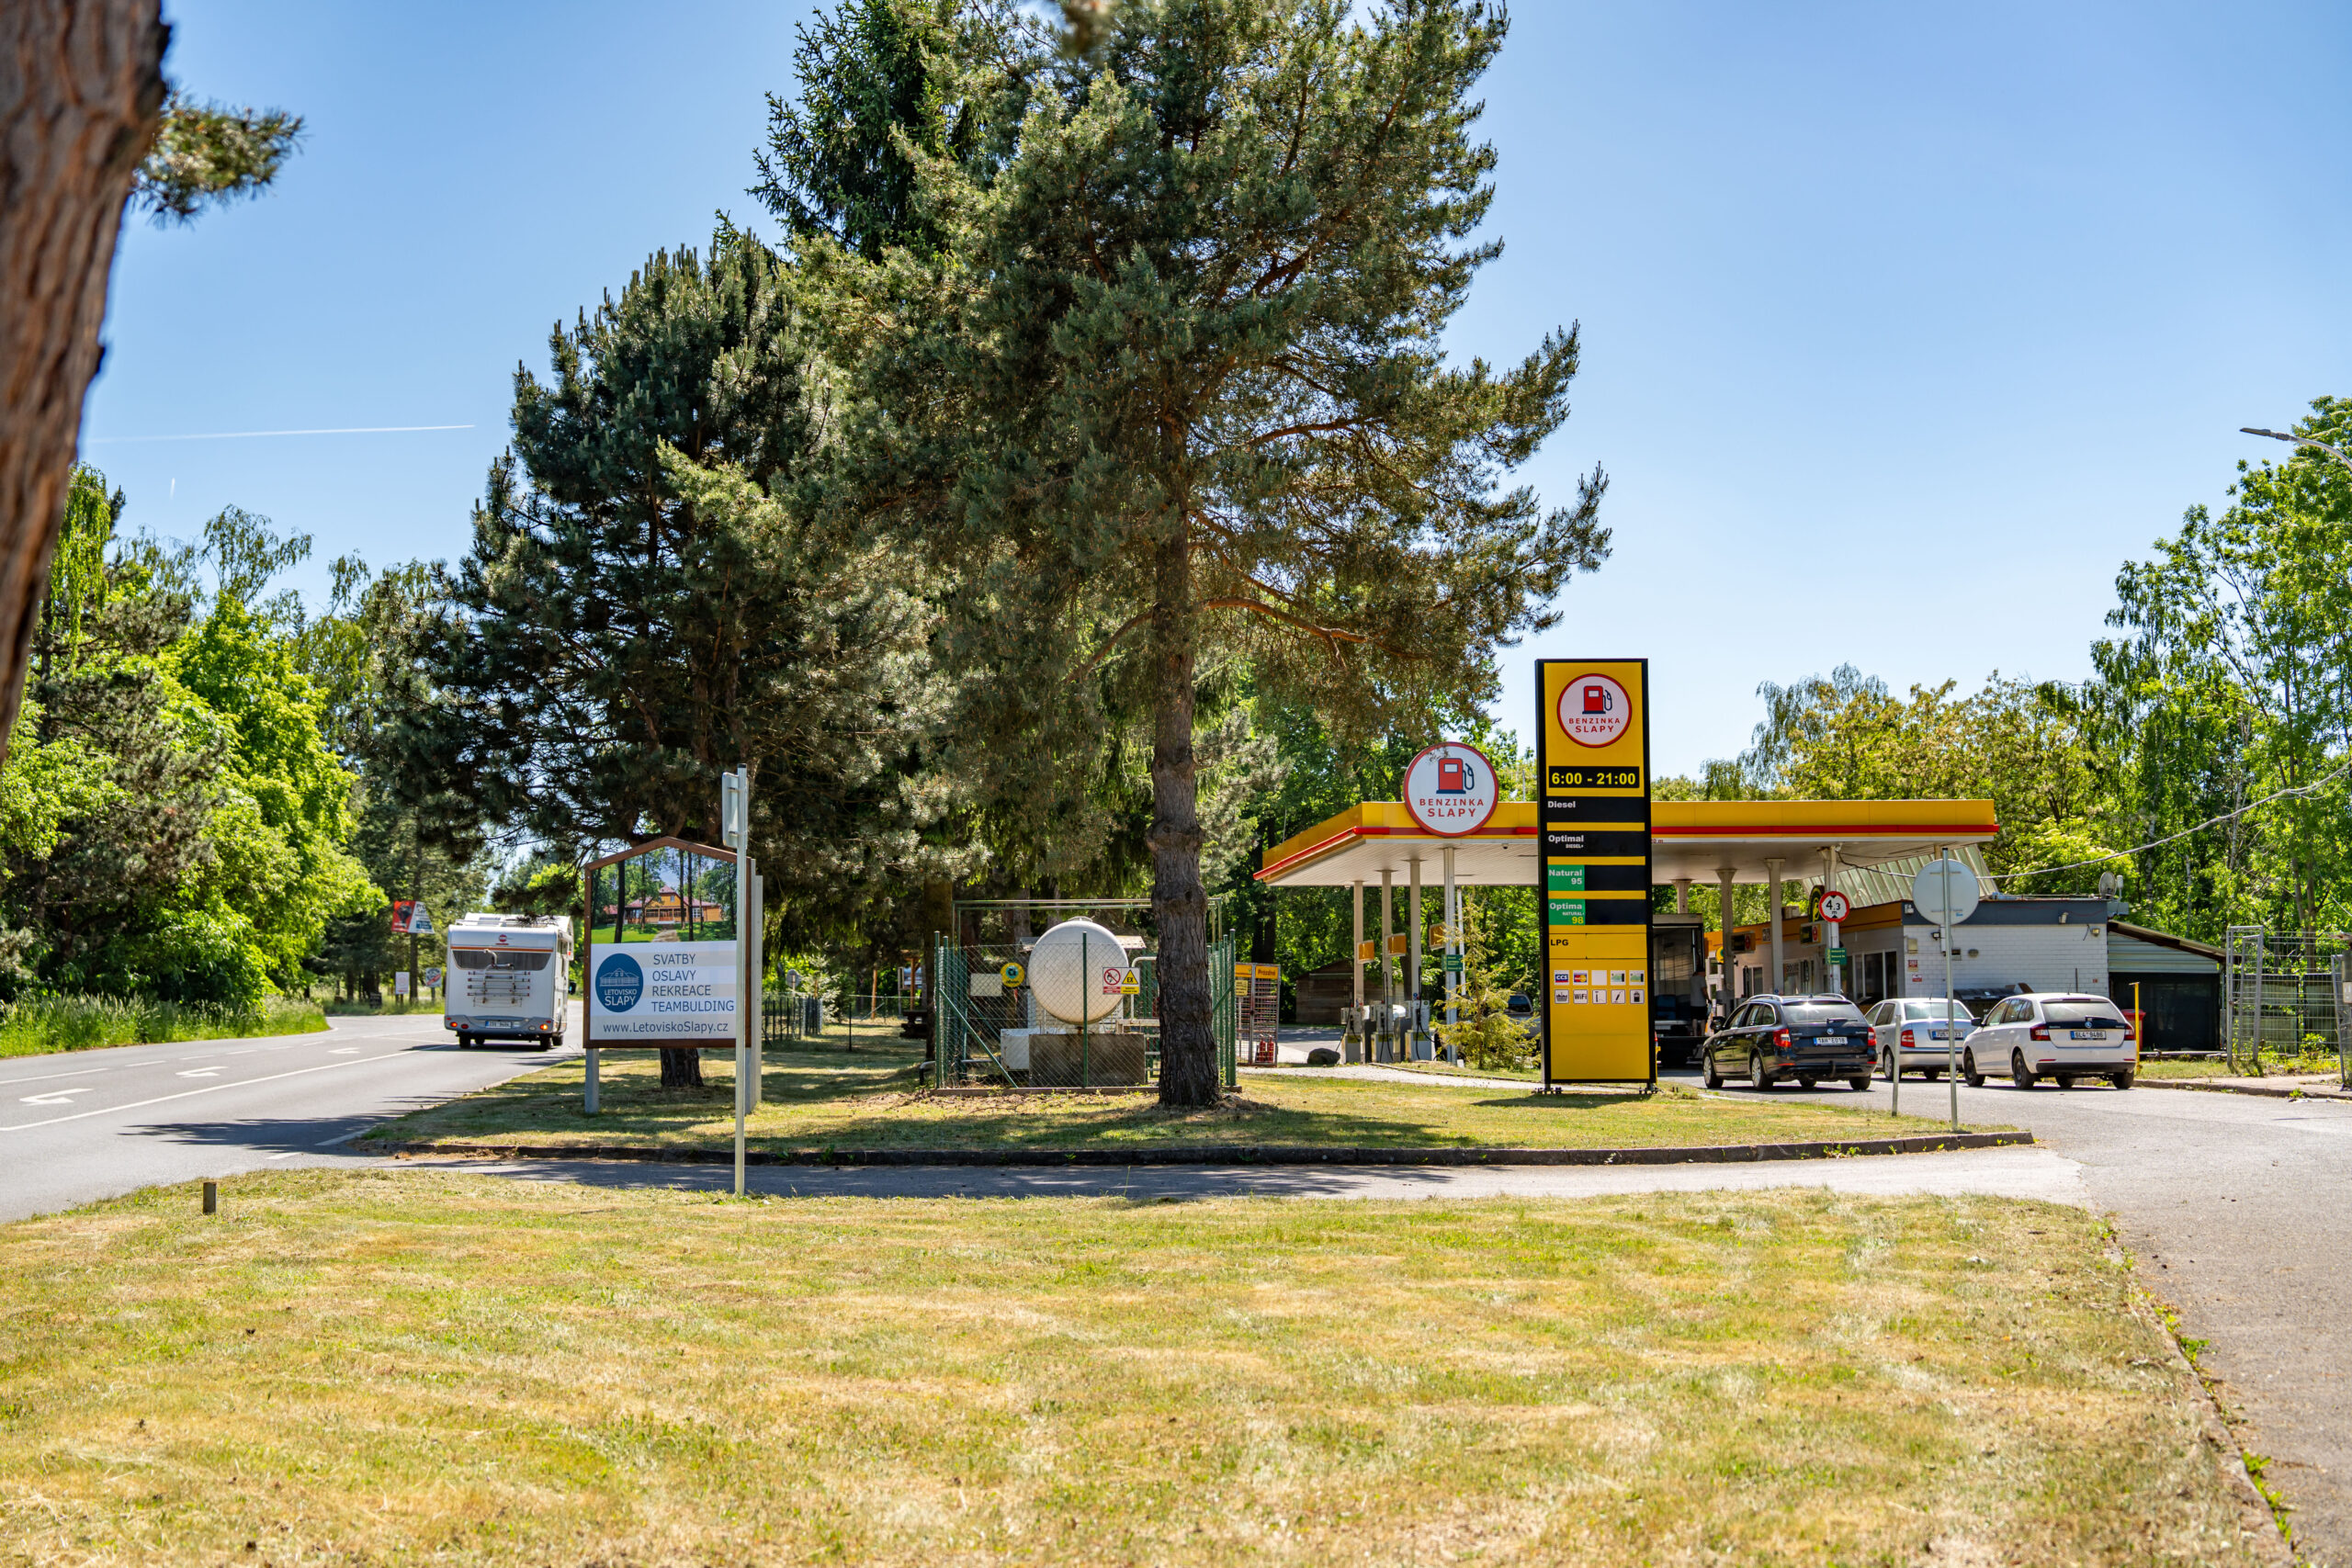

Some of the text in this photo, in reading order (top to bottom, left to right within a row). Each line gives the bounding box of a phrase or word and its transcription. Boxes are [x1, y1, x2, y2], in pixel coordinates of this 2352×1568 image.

[1575, 725, 1614, 733] SLAPY
[1552, 773, 1582, 784] 6:00
[1597, 773, 1636, 784] 21:00
[1419, 798, 1484, 807] BENZINKA
[1547, 800, 1576, 808] Diesel
[1428, 808, 1476, 817] SLAPY
[1548, 835, 1584, 843] Optimal
[1571, 916, 1584, 924] 98
[653, 953, 696, 965] SVATBY
[652, 970, 696, 982] OSLAVY
[651, 985, 712, 997] REKREACE
[605, 996, 637, 1007] SLAPY
[650, 1000, 735, 1012] TEAMBULDING
[603, 1021, 729, 1034] www.LetoviskoSlapy.cz
